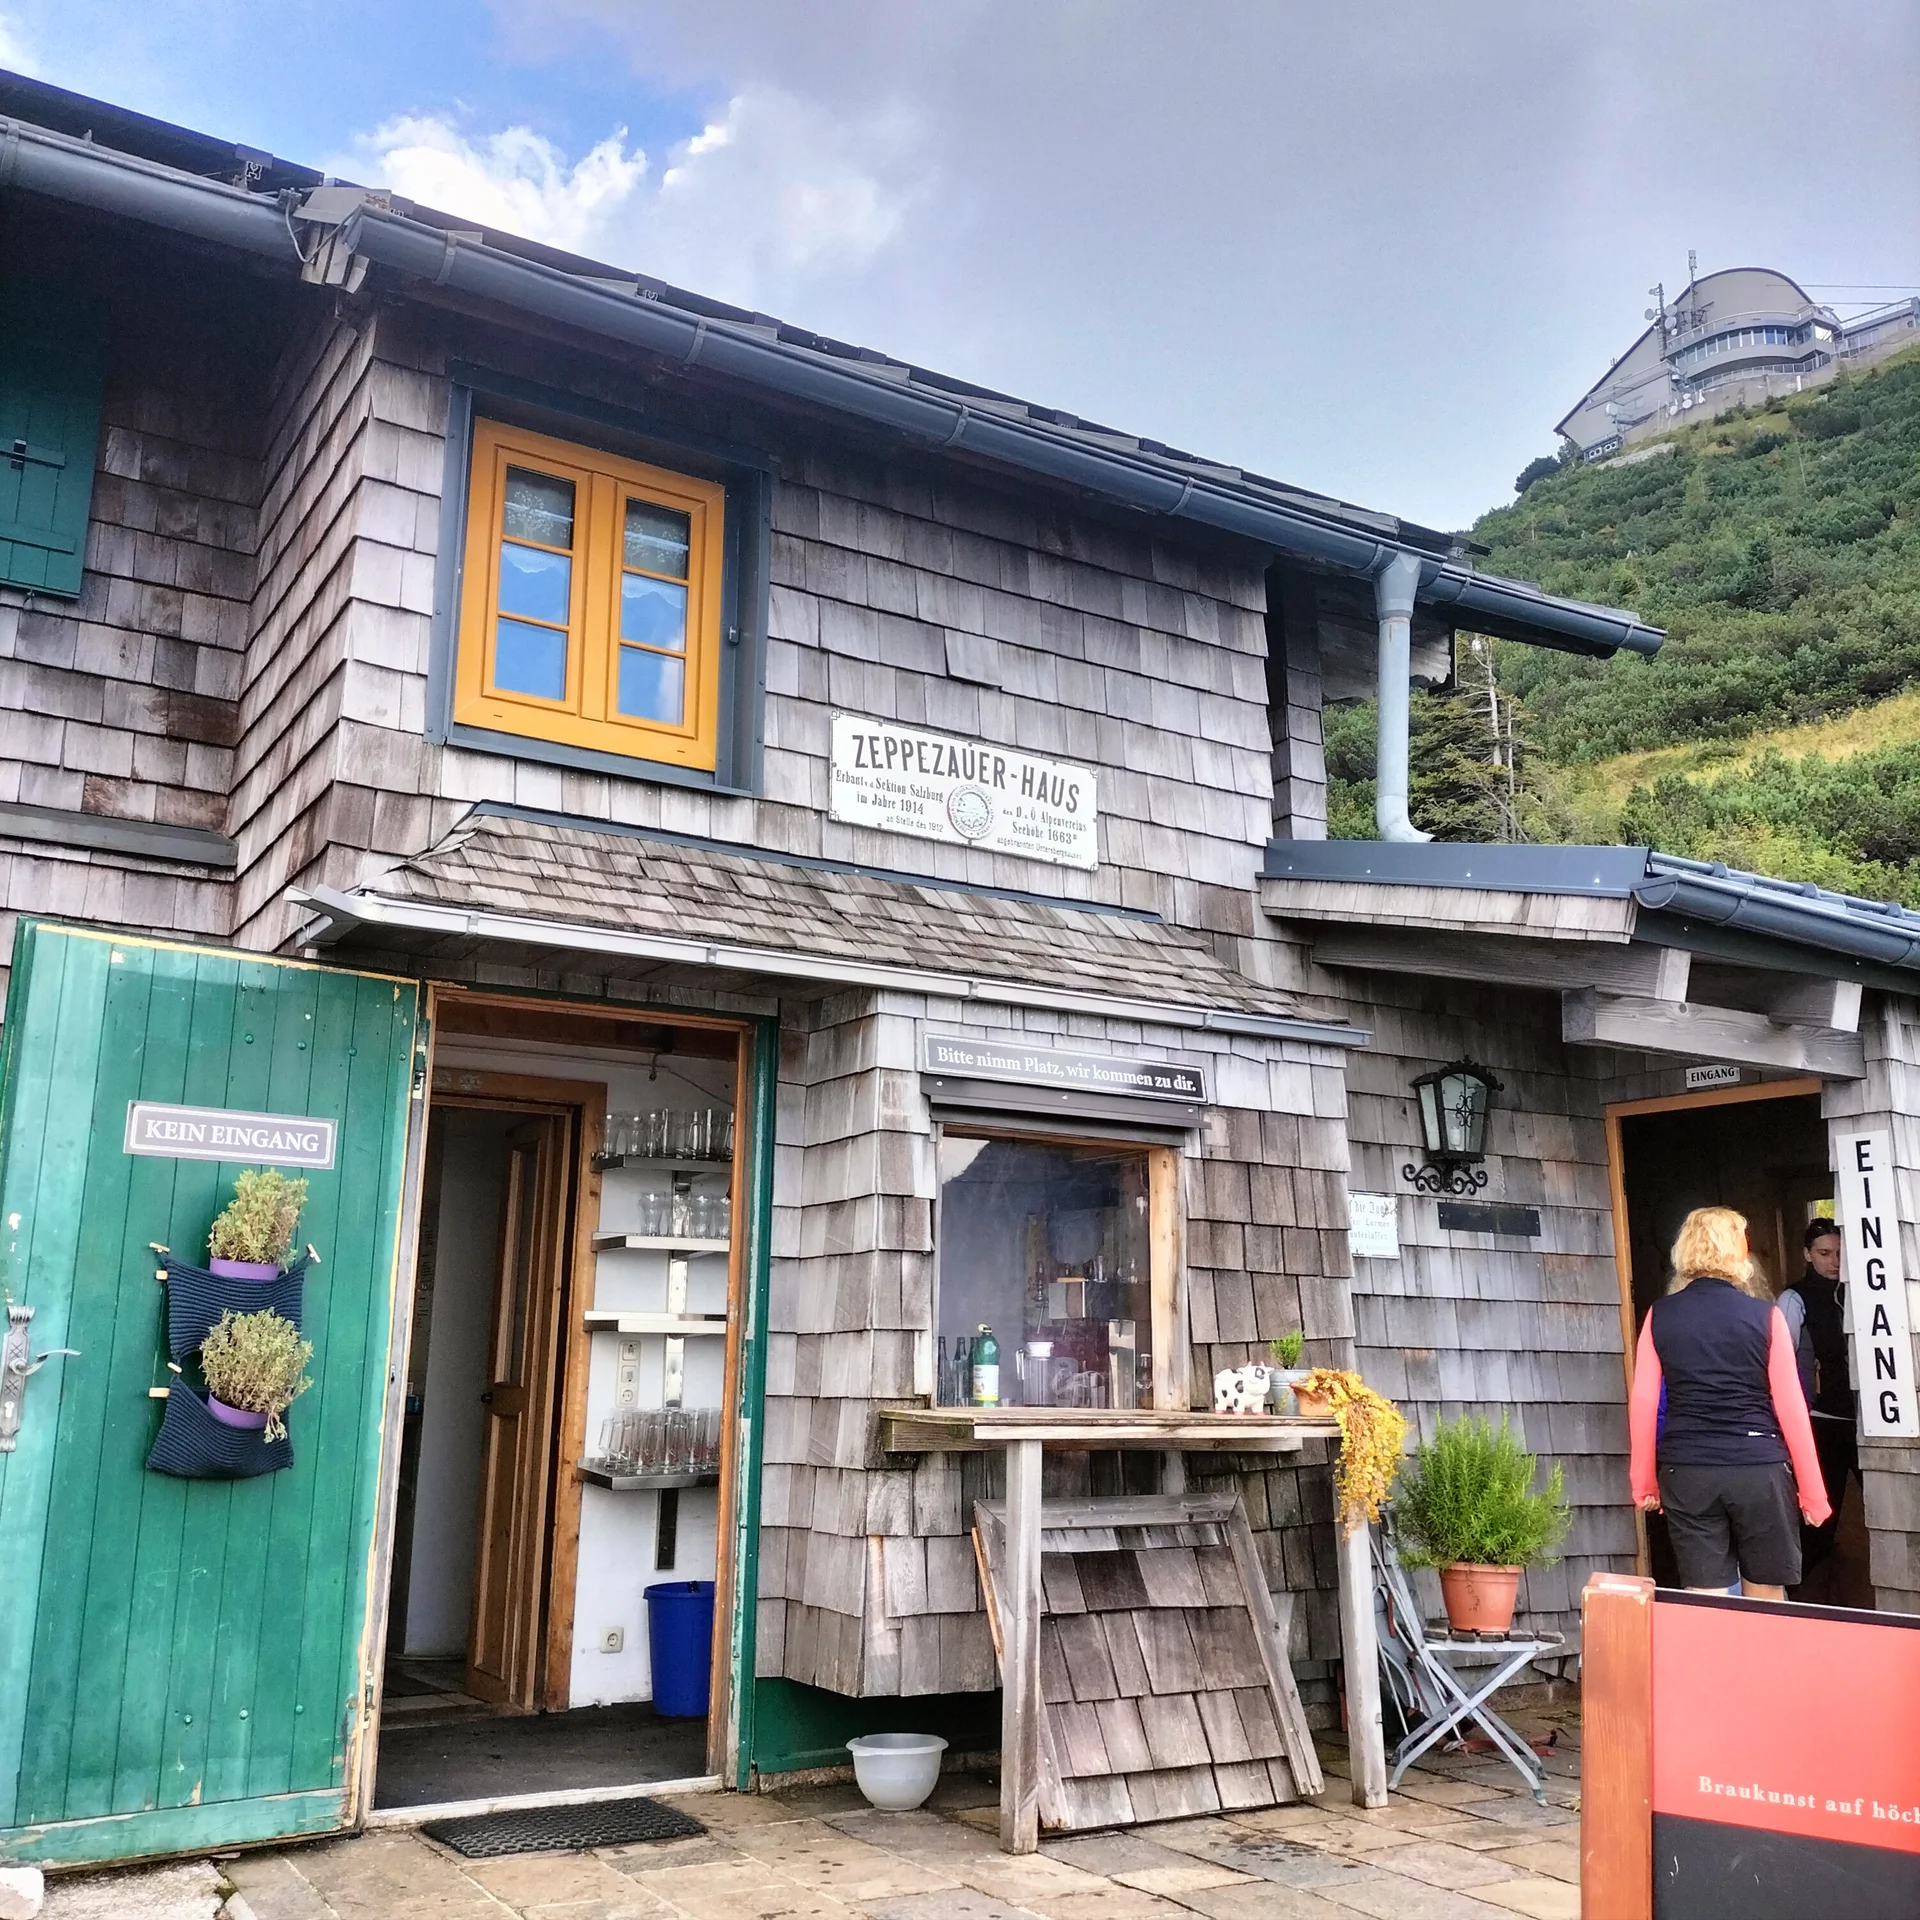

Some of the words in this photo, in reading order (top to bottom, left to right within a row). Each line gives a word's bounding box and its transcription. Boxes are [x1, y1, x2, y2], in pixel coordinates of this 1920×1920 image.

[836, 769, 864, 786] Erbaut
[876, 777, 906, 794] Sektion
[910, 784, 944, 803] Salzburg
[851, 734, 1080, 813] ZEPPEZAUER-HAUS
[857, 791, 867, 804] im
[872, 793, 896, 809] Jahre
[901, 799, 924, 815] 1914
[896, 816, 914, 827] Stelle
[916, 820, 926, 829] des
[928, 822, 944, 833] 1912
[1012, 821, 1044, 839] Seehöhe
[1040, 811, 1087, 832] Alpenvereins
[937, 1046, 974, 1065] Bitte
[976, 1053, 1021, 1071] nimm
[1024, 1057, 1065, 1077] Platz,
[1065, 1063, 1091, 1079] wir
[1092, 1066, 1153, 1086] kommen
[1155, 1077, 1172, 1088] zu
[1173, 1075, 1197, 1092] dir.
[1691, 1067, 1735, 1082] EINGANG
[145, 1119, 207, 1143] KEIN
[209, 1126, 319, 1152] EINGANG
[1855, 1139, 1901, 1424] EINGANG
[1698, 1775, 1816, 1808] Braukunst
[1825, 1798, 1865, 1815] auf
